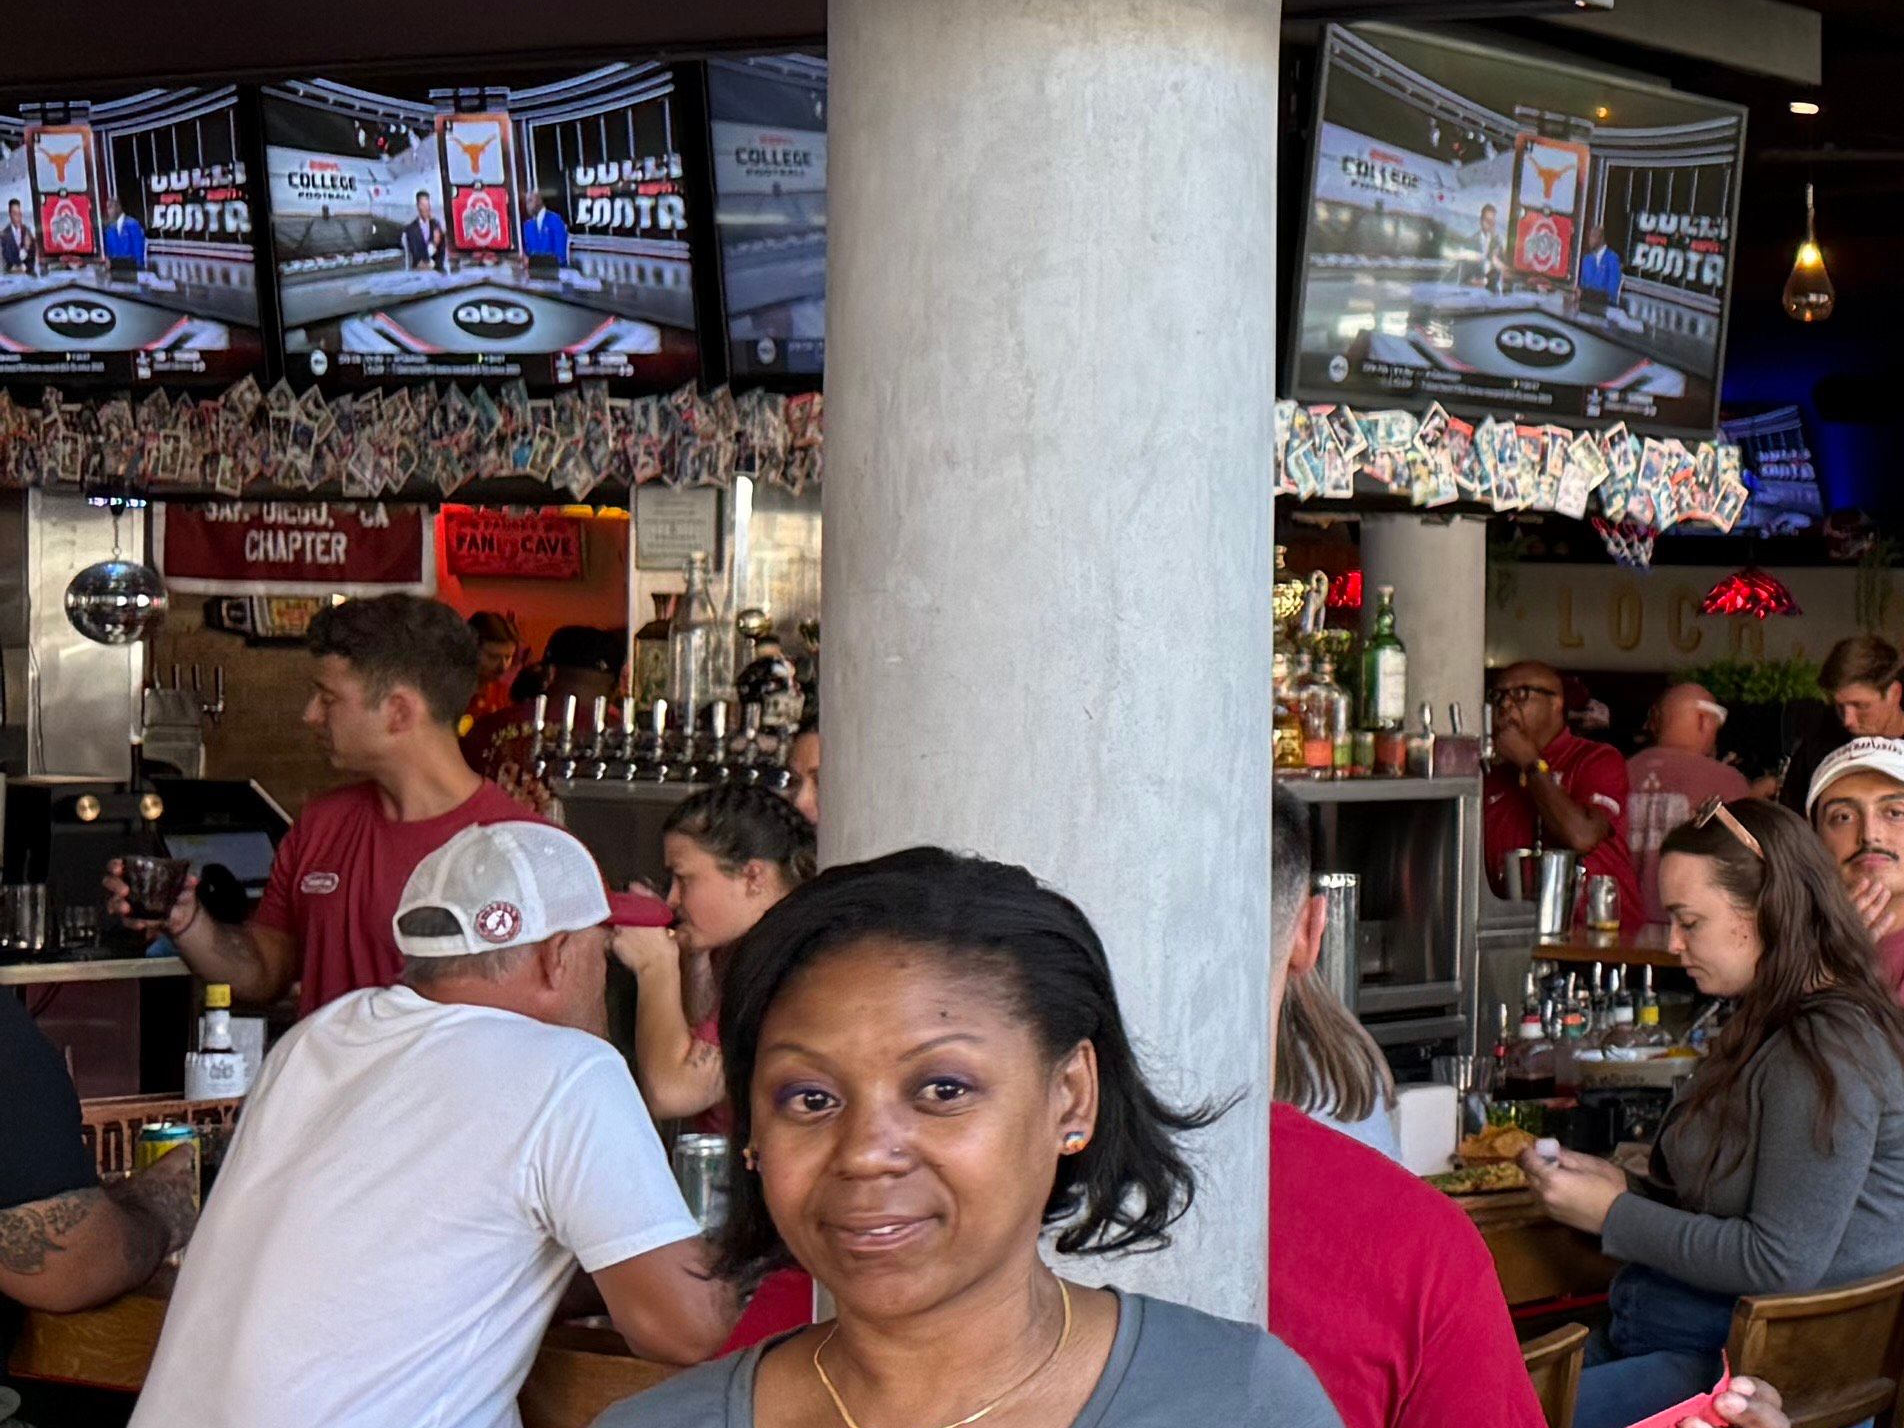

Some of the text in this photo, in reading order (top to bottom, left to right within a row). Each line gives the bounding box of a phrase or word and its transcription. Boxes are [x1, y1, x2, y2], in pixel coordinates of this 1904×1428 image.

[735, 147, 812, 166] COLLEGE
[287, 171, 357, 193] COLLEGE
[244, 529, 348, 564] CHAPTER
[520, 534, 574, 557] CAVE
